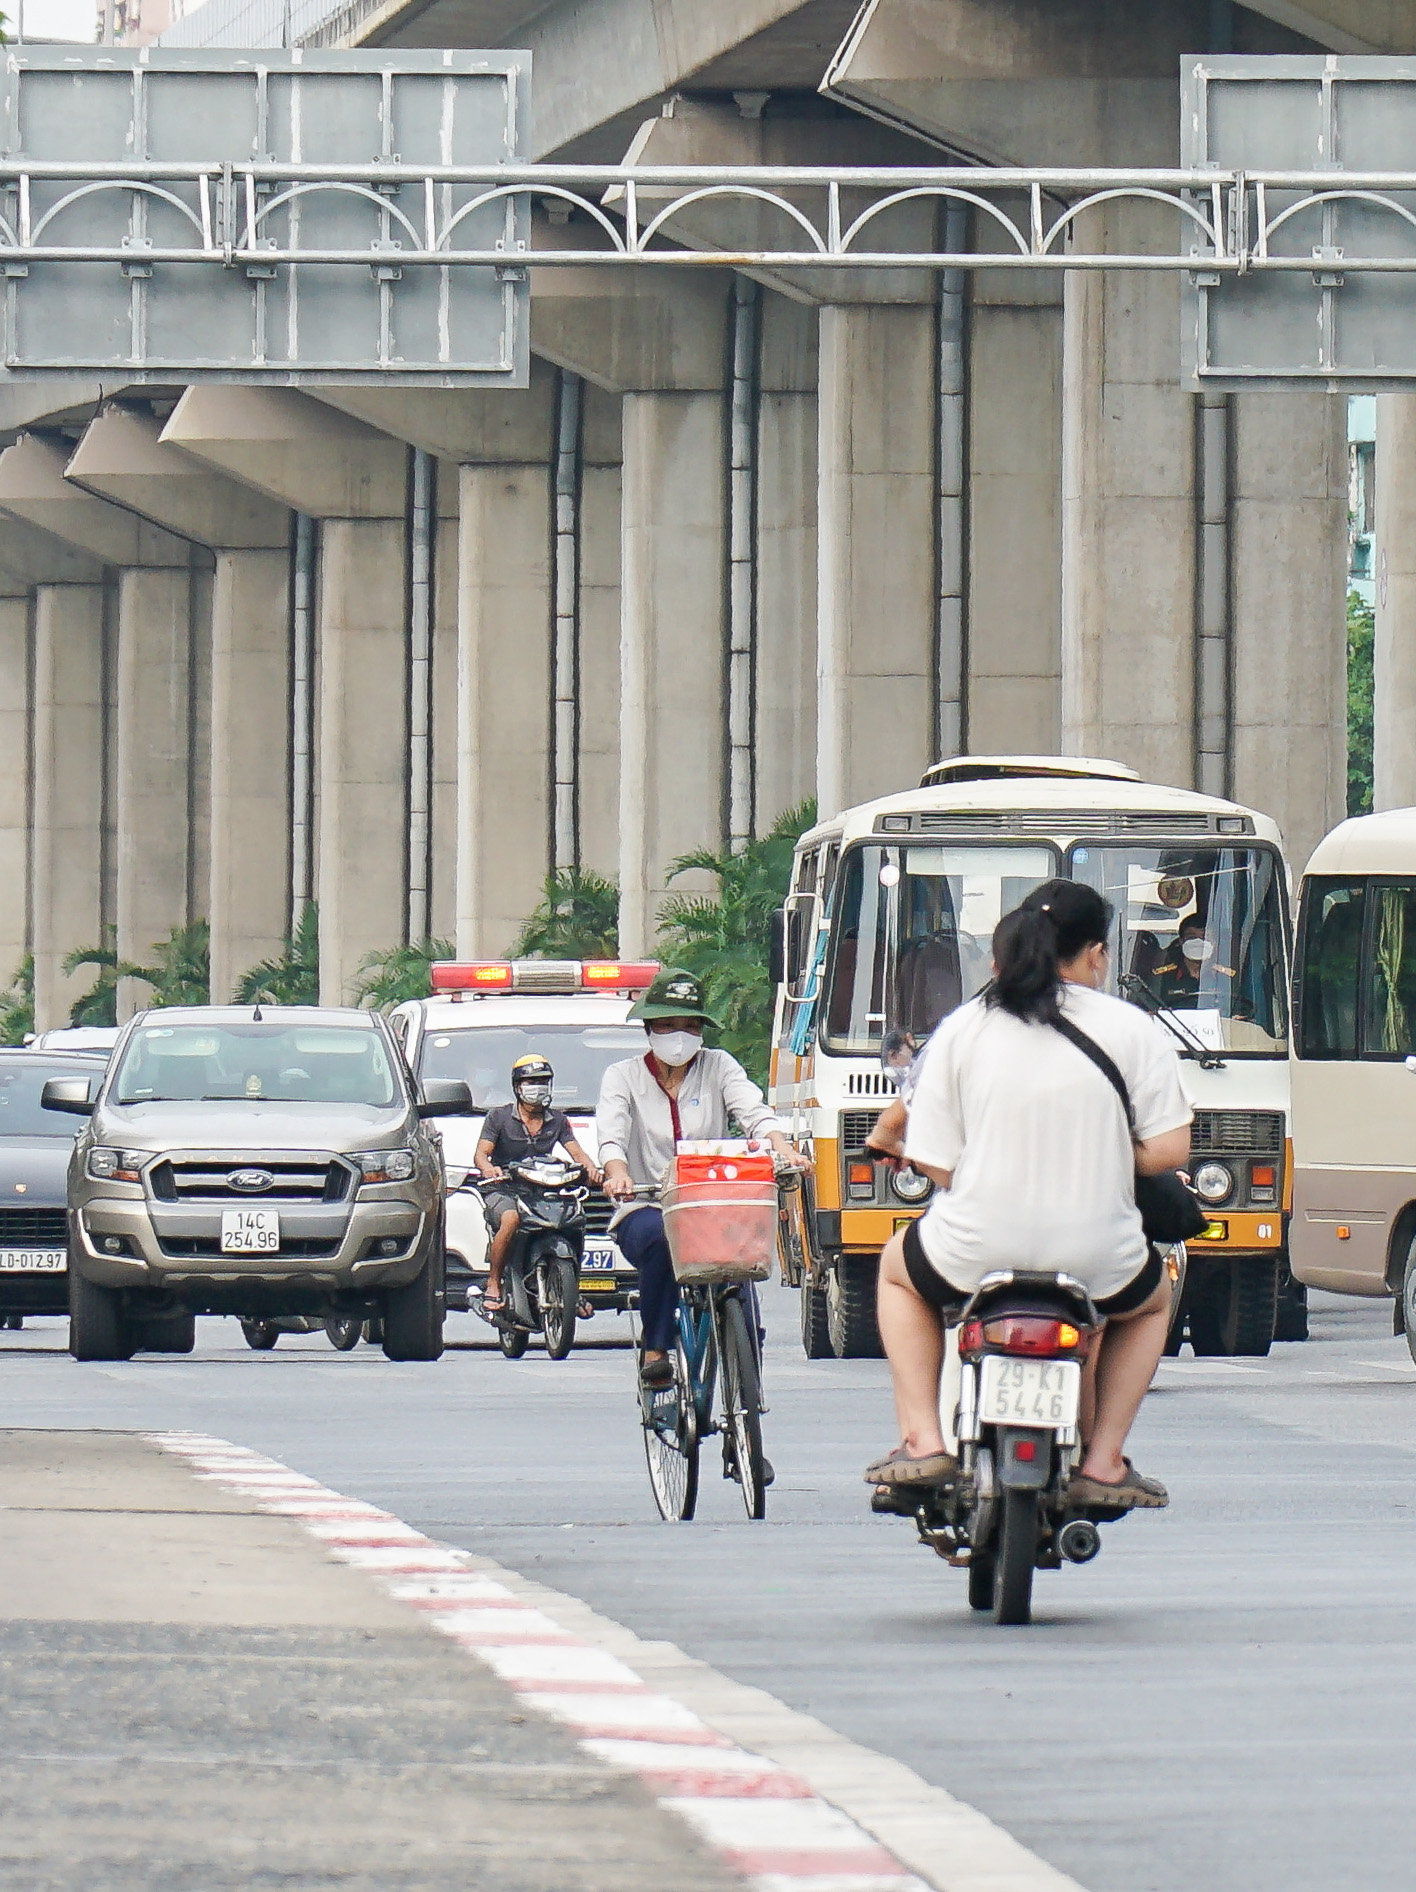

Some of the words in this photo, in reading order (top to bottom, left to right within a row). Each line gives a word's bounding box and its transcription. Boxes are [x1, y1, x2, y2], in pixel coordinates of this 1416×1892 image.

[237, 1213, 265, 1231] 14C
[224, 1232, 278, 1249] 254.96
[996, 1388, 1063, 1418] 5446
